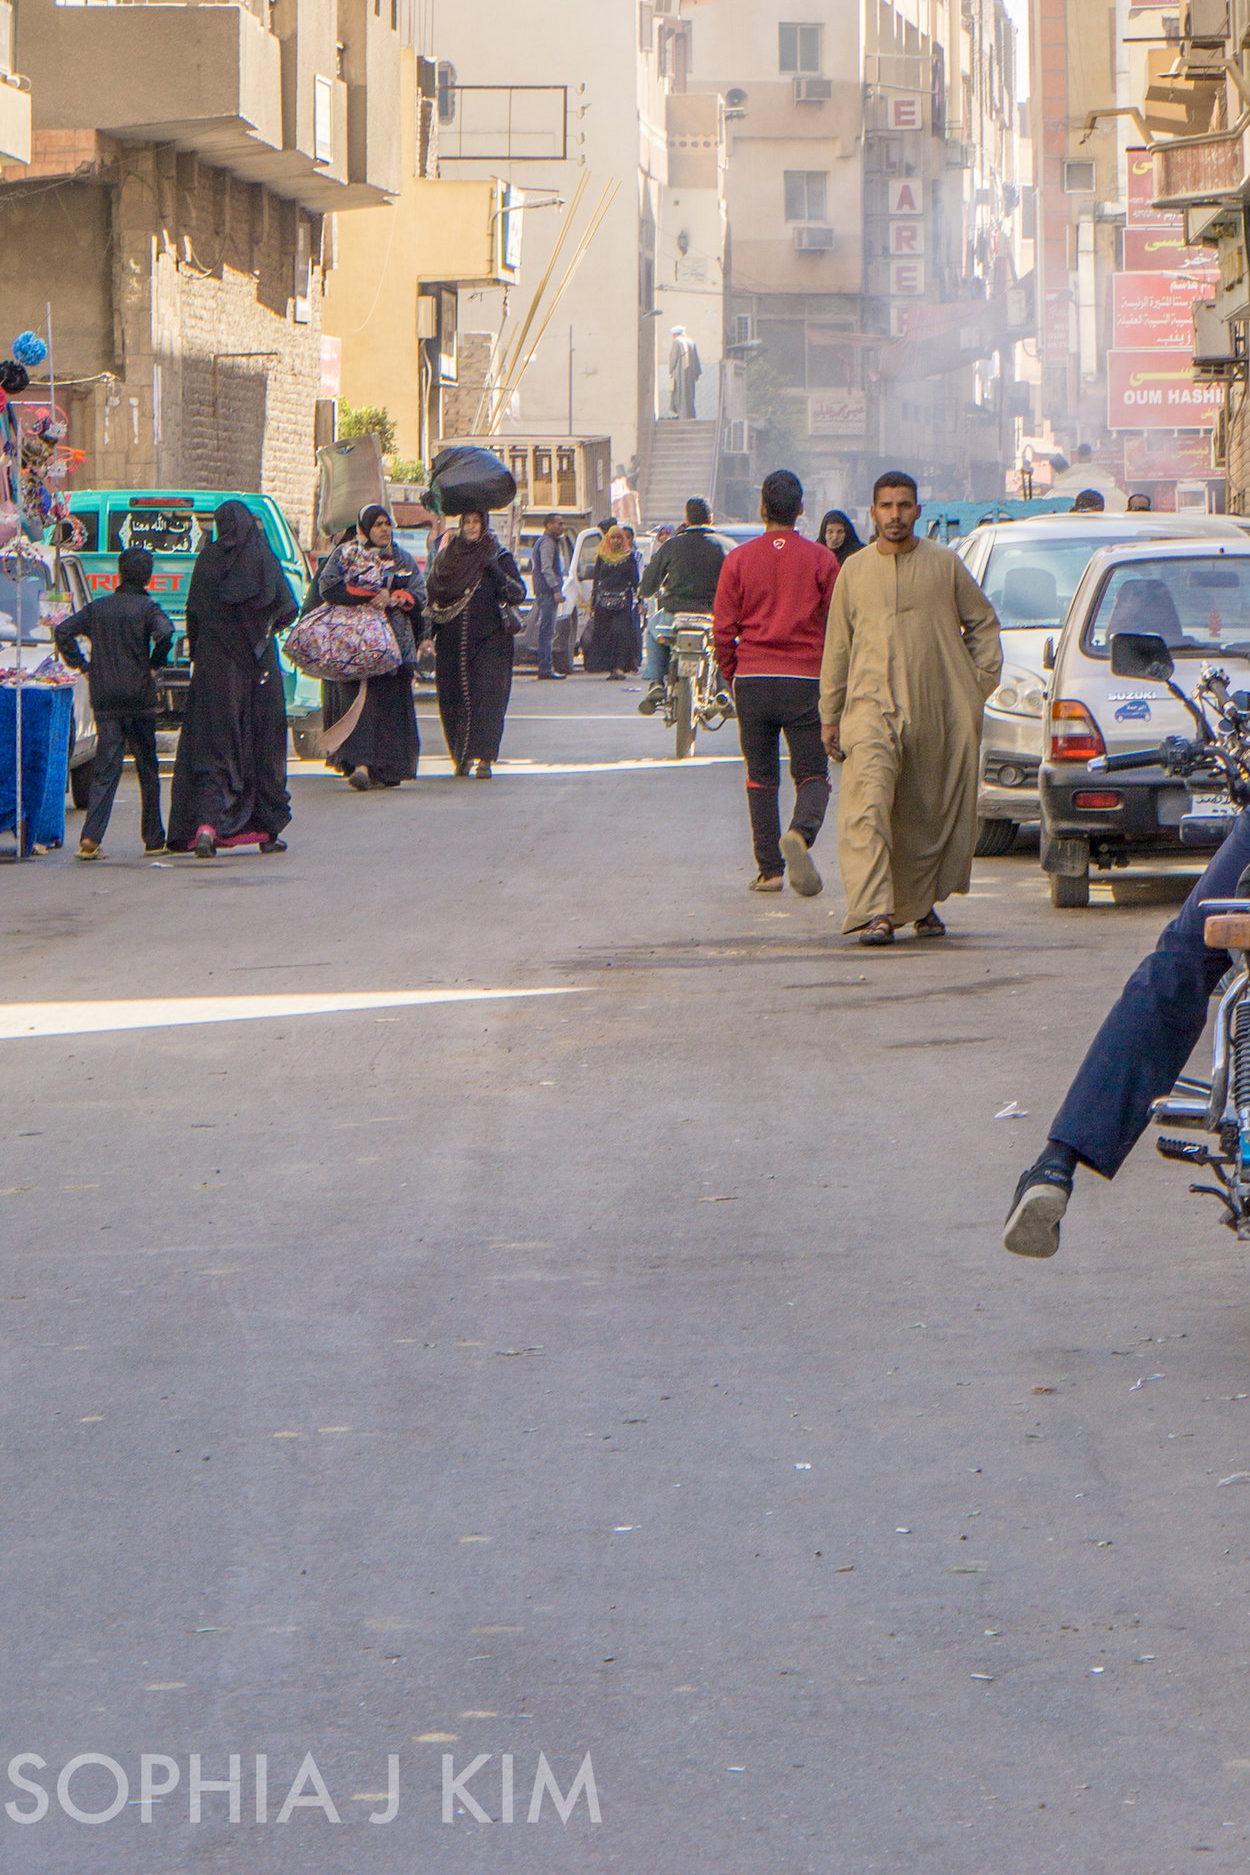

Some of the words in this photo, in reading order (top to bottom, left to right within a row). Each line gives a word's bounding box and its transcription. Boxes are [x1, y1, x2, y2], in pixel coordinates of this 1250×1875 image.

[1123, 389, 1162, 405] OUM
[151, 513, 167, 533] الله
[1108, 691, 1157, 701] SUZUKI
